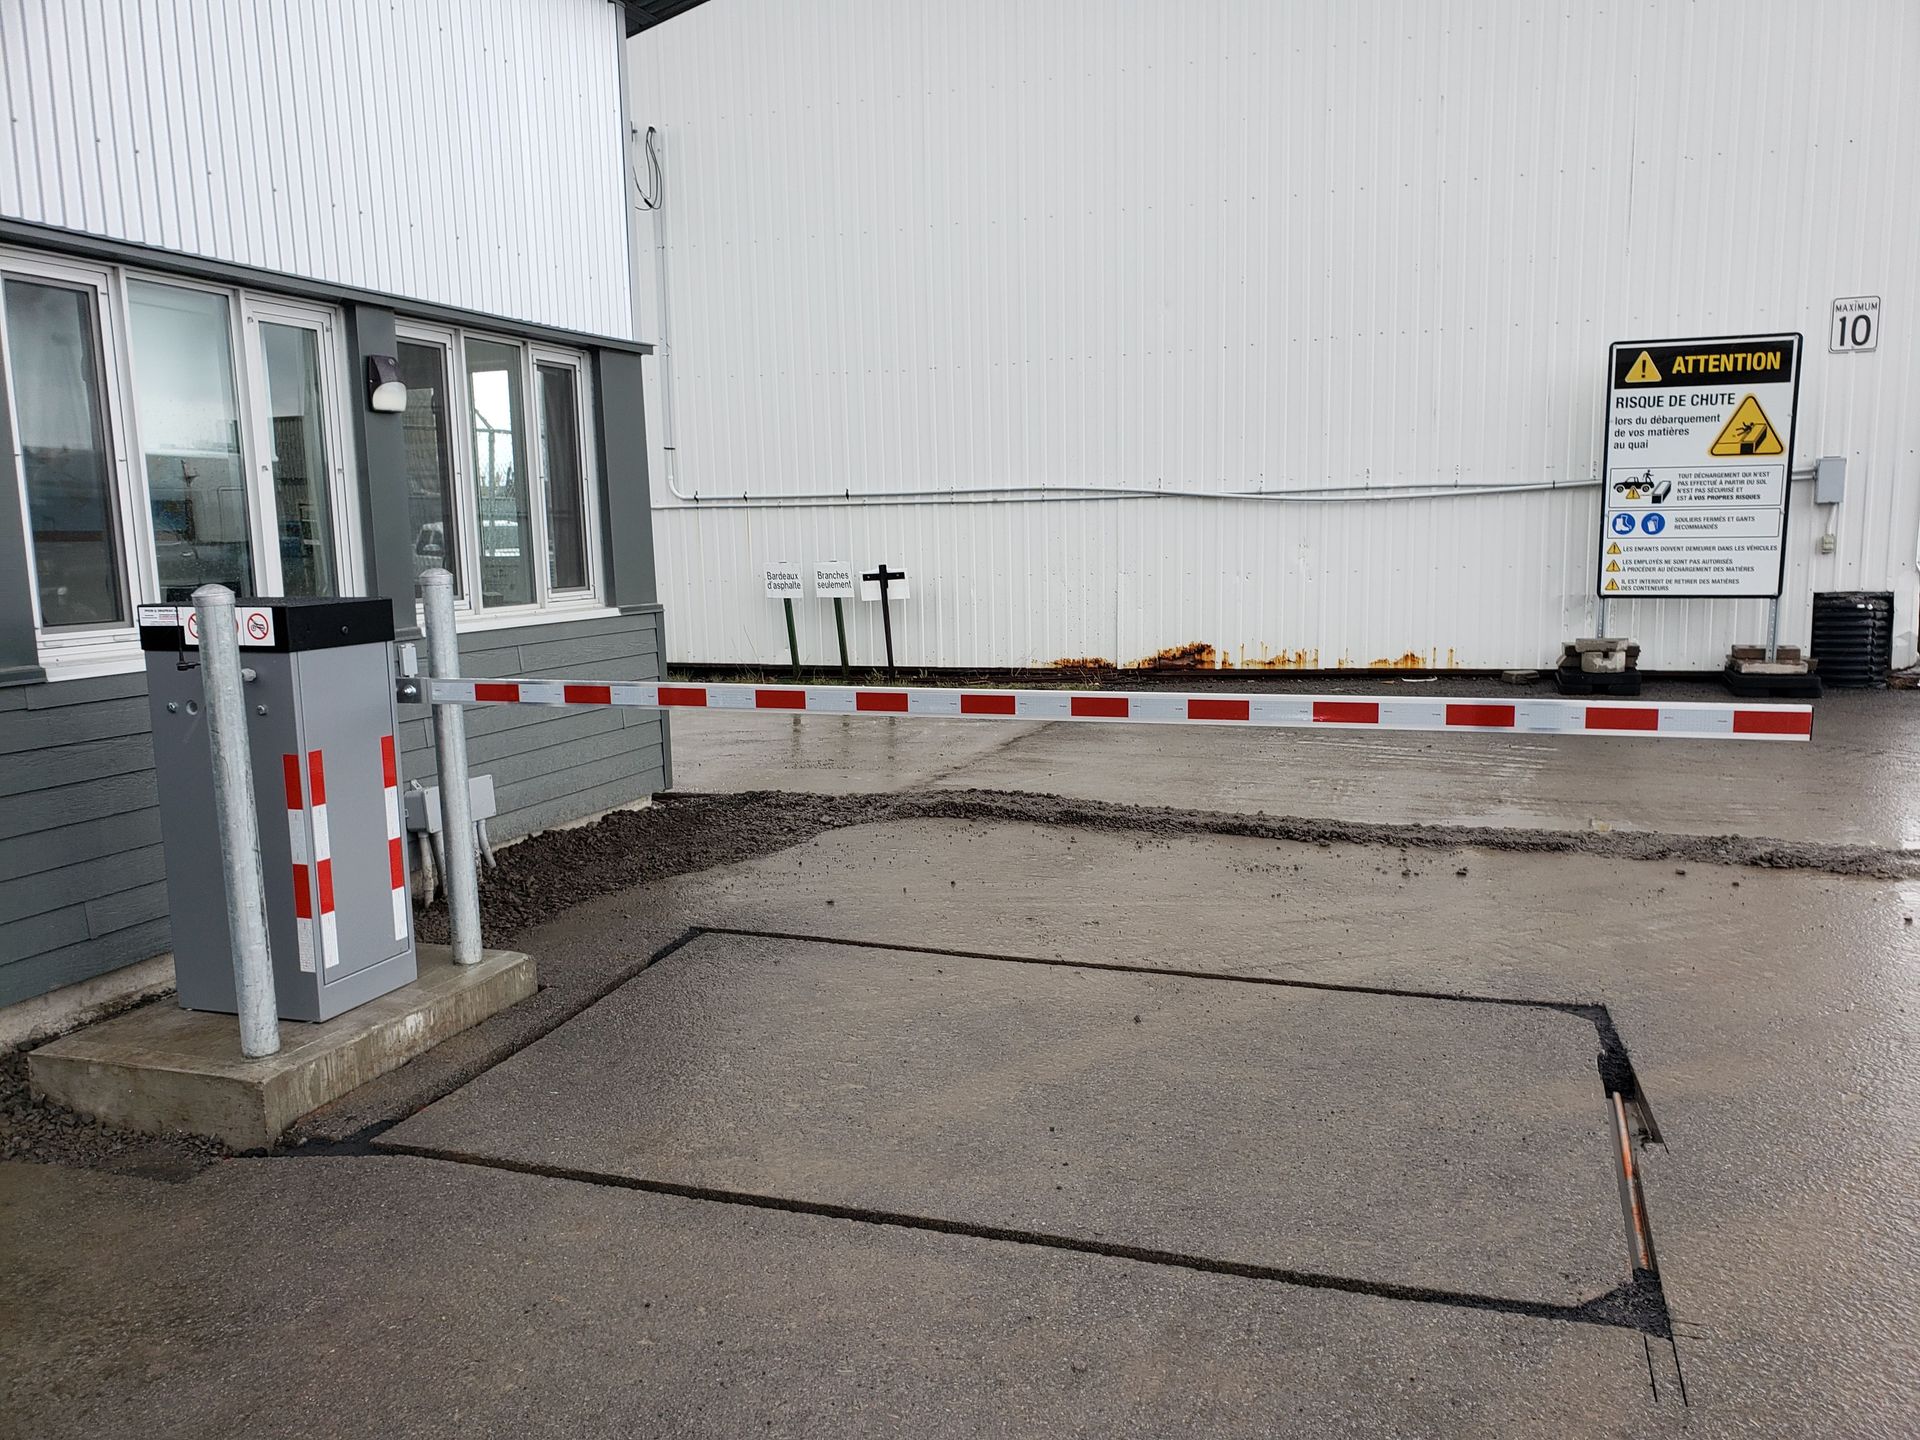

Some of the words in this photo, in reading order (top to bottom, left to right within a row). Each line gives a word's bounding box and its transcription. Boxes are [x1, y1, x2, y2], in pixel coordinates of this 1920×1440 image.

[1835, 302, 1878, 312] MAXIMUM
[1839, 314, 1872, 346] 10
[1672, 351, 1781, 374] ATTENTION
[1616, 396, 1664, 409] RISQUE
[1669, 394, 1686, 407] DE
[1690, 393, 1736, 406] CHUTE
[1615, 416, 1633, 425] lors
[1635, 416, 1648, 425] du
[1650, 413, 1721, 425] débarquement
[1614, 428, 1626, 437] de
[1628, 428, 1645, 437] vos
[1648, 427, 1690, 436] matières
[1613, 441, 1625, 449] au
[1628, 439, 1649, 451] quai
[766, 571, 799, 580] Bardeaux
[817, 570, 849, 580] Branches
[767, 580, 801, 590] d'asphalte
[817, 580, 852, 589] seulement
